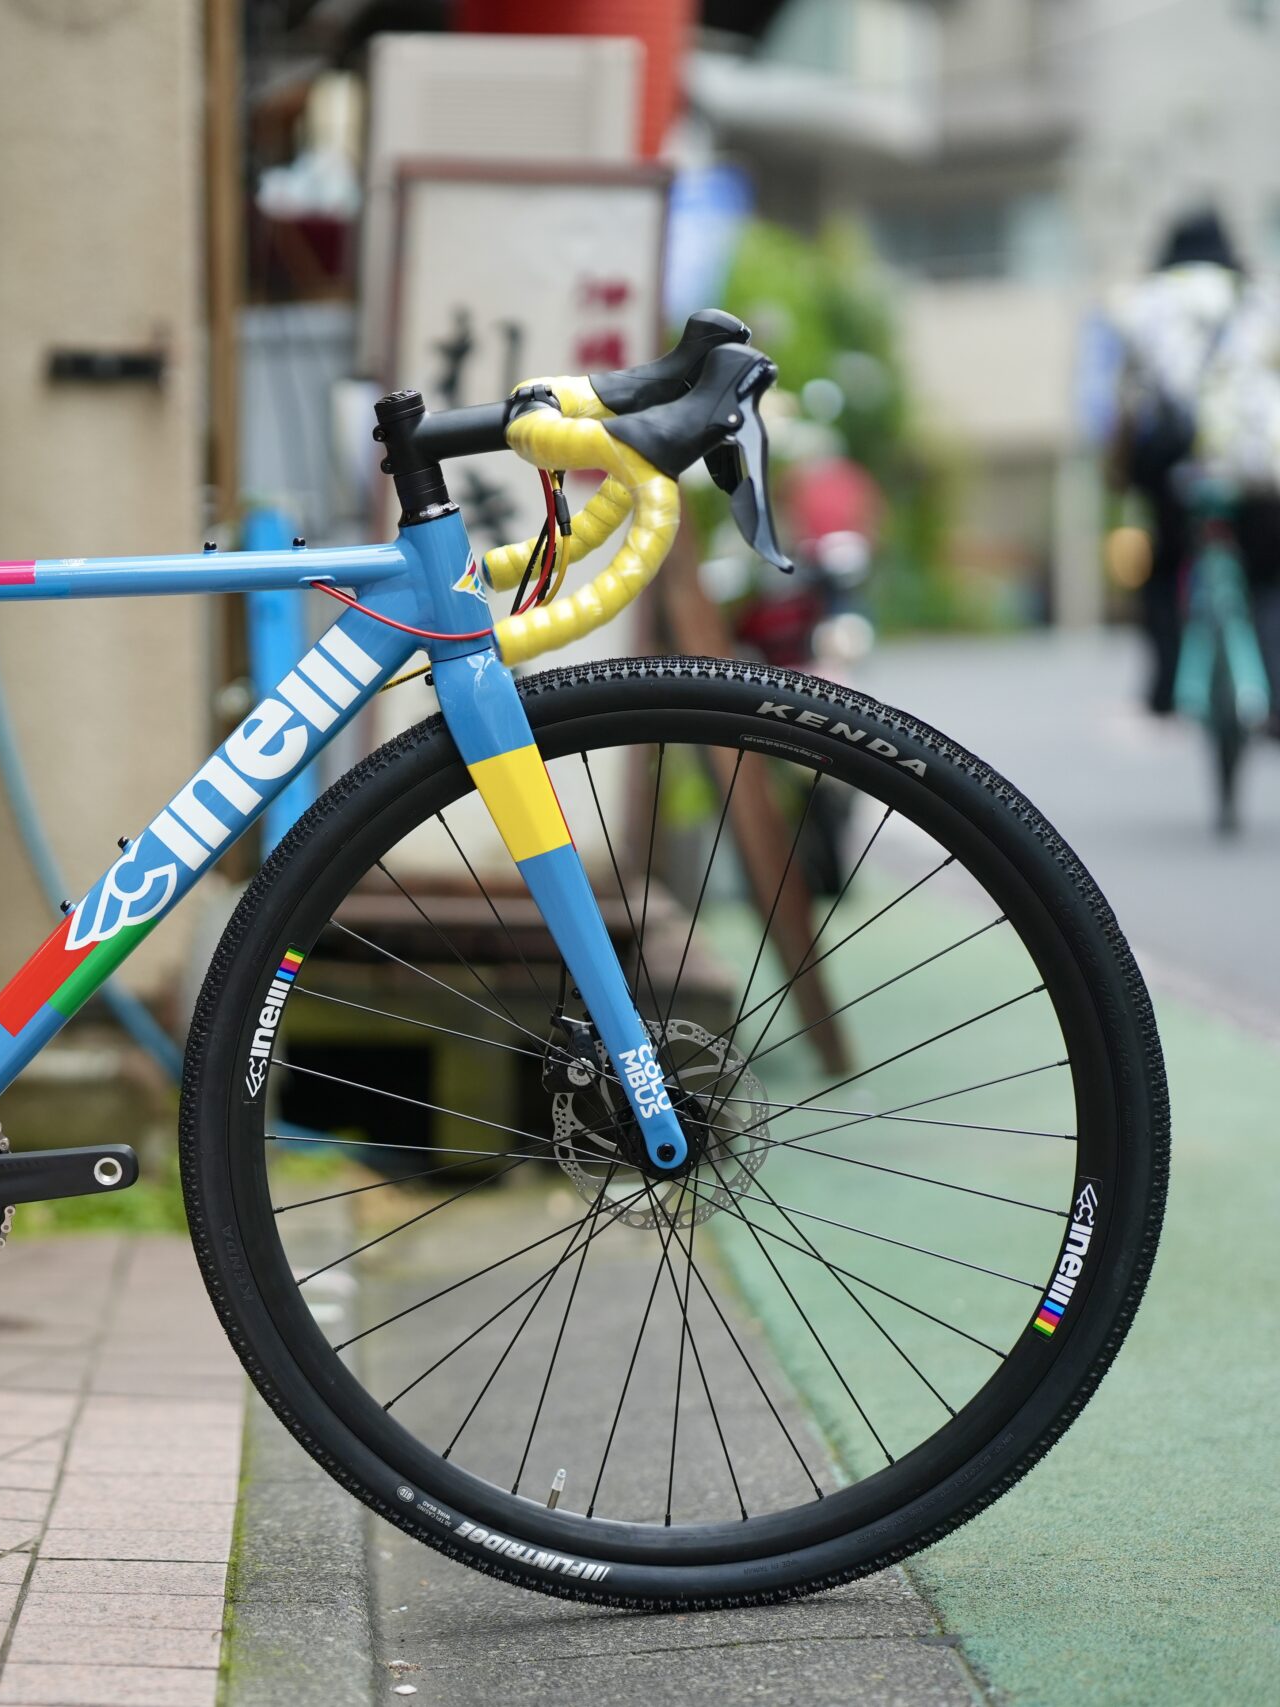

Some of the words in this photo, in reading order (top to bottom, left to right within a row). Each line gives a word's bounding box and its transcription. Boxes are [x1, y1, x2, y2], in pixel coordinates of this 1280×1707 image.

[756, 701, 928, 778] KENDA
[619, 1049, 661, 1119] MBUS
[453, 1521, 586, 1578] FLINTRIDGE
